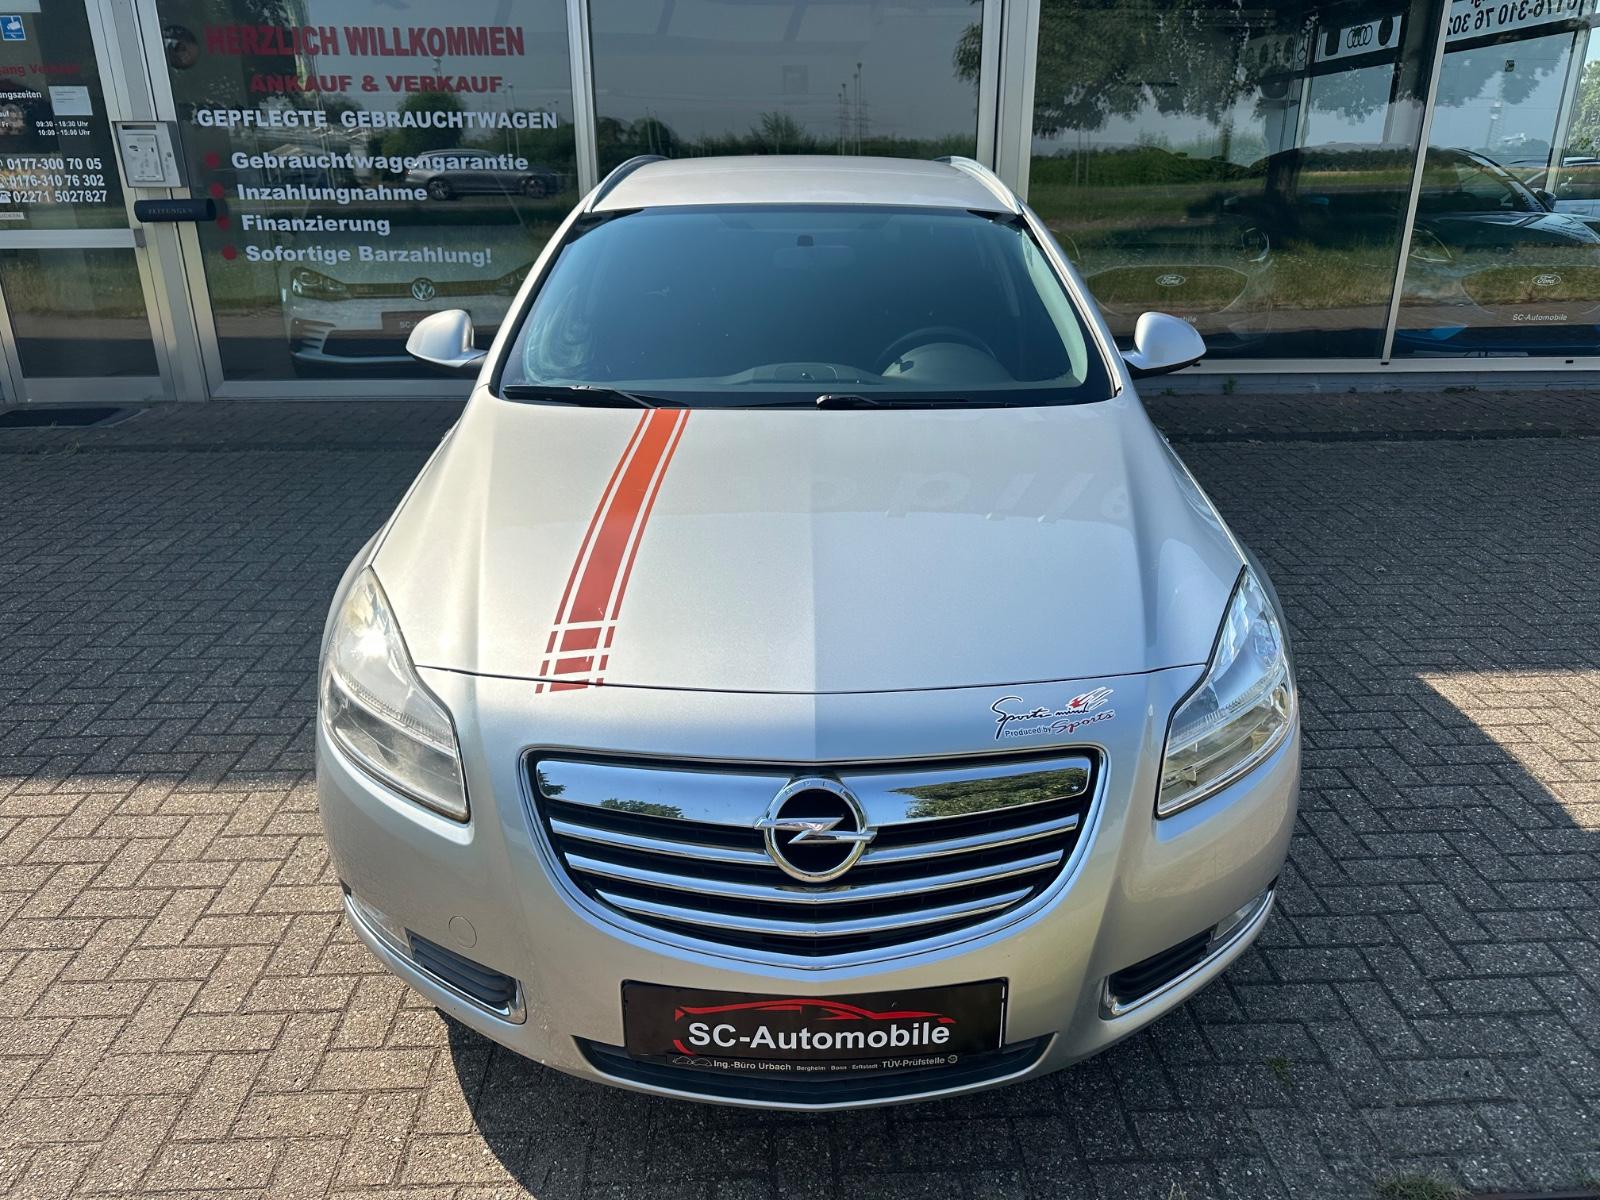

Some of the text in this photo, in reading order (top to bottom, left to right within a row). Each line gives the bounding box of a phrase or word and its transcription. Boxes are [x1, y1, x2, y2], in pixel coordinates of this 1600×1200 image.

[205, 24, 524, 57] HERZLICH WILLKOMMEN
[250, 75, 502, 92] ANKAUF & VERKAUF
[197, 109, 558, 129] GEPFLEGTE GEBRAUCHTWAGEN
[7, 158, 102, 170] 0177-300 70 05
[231, 152, 529, 173] Gebrauchtwagengarantie
[9, 174, 105, 188] 0176-310 76 302
[13, 190, 107, 203] 02271 5027827
[237, 184, 428, 204] Inzahlungnahme
[241, 214, 391, 236] Finanzierung
[246, 245, 492, 267] Sofortige Barzahlung!
[1004, 710, 1115, 737] Produced by Sports
[688, 1021, 951, 1050] SC-Automobile
[713, 1060, 756, 1070] Ing.-Büro
[758, 1062, 792, 1071] Urbach
[882, 1056, 945, 1069] TÜV-Prüfstelle
